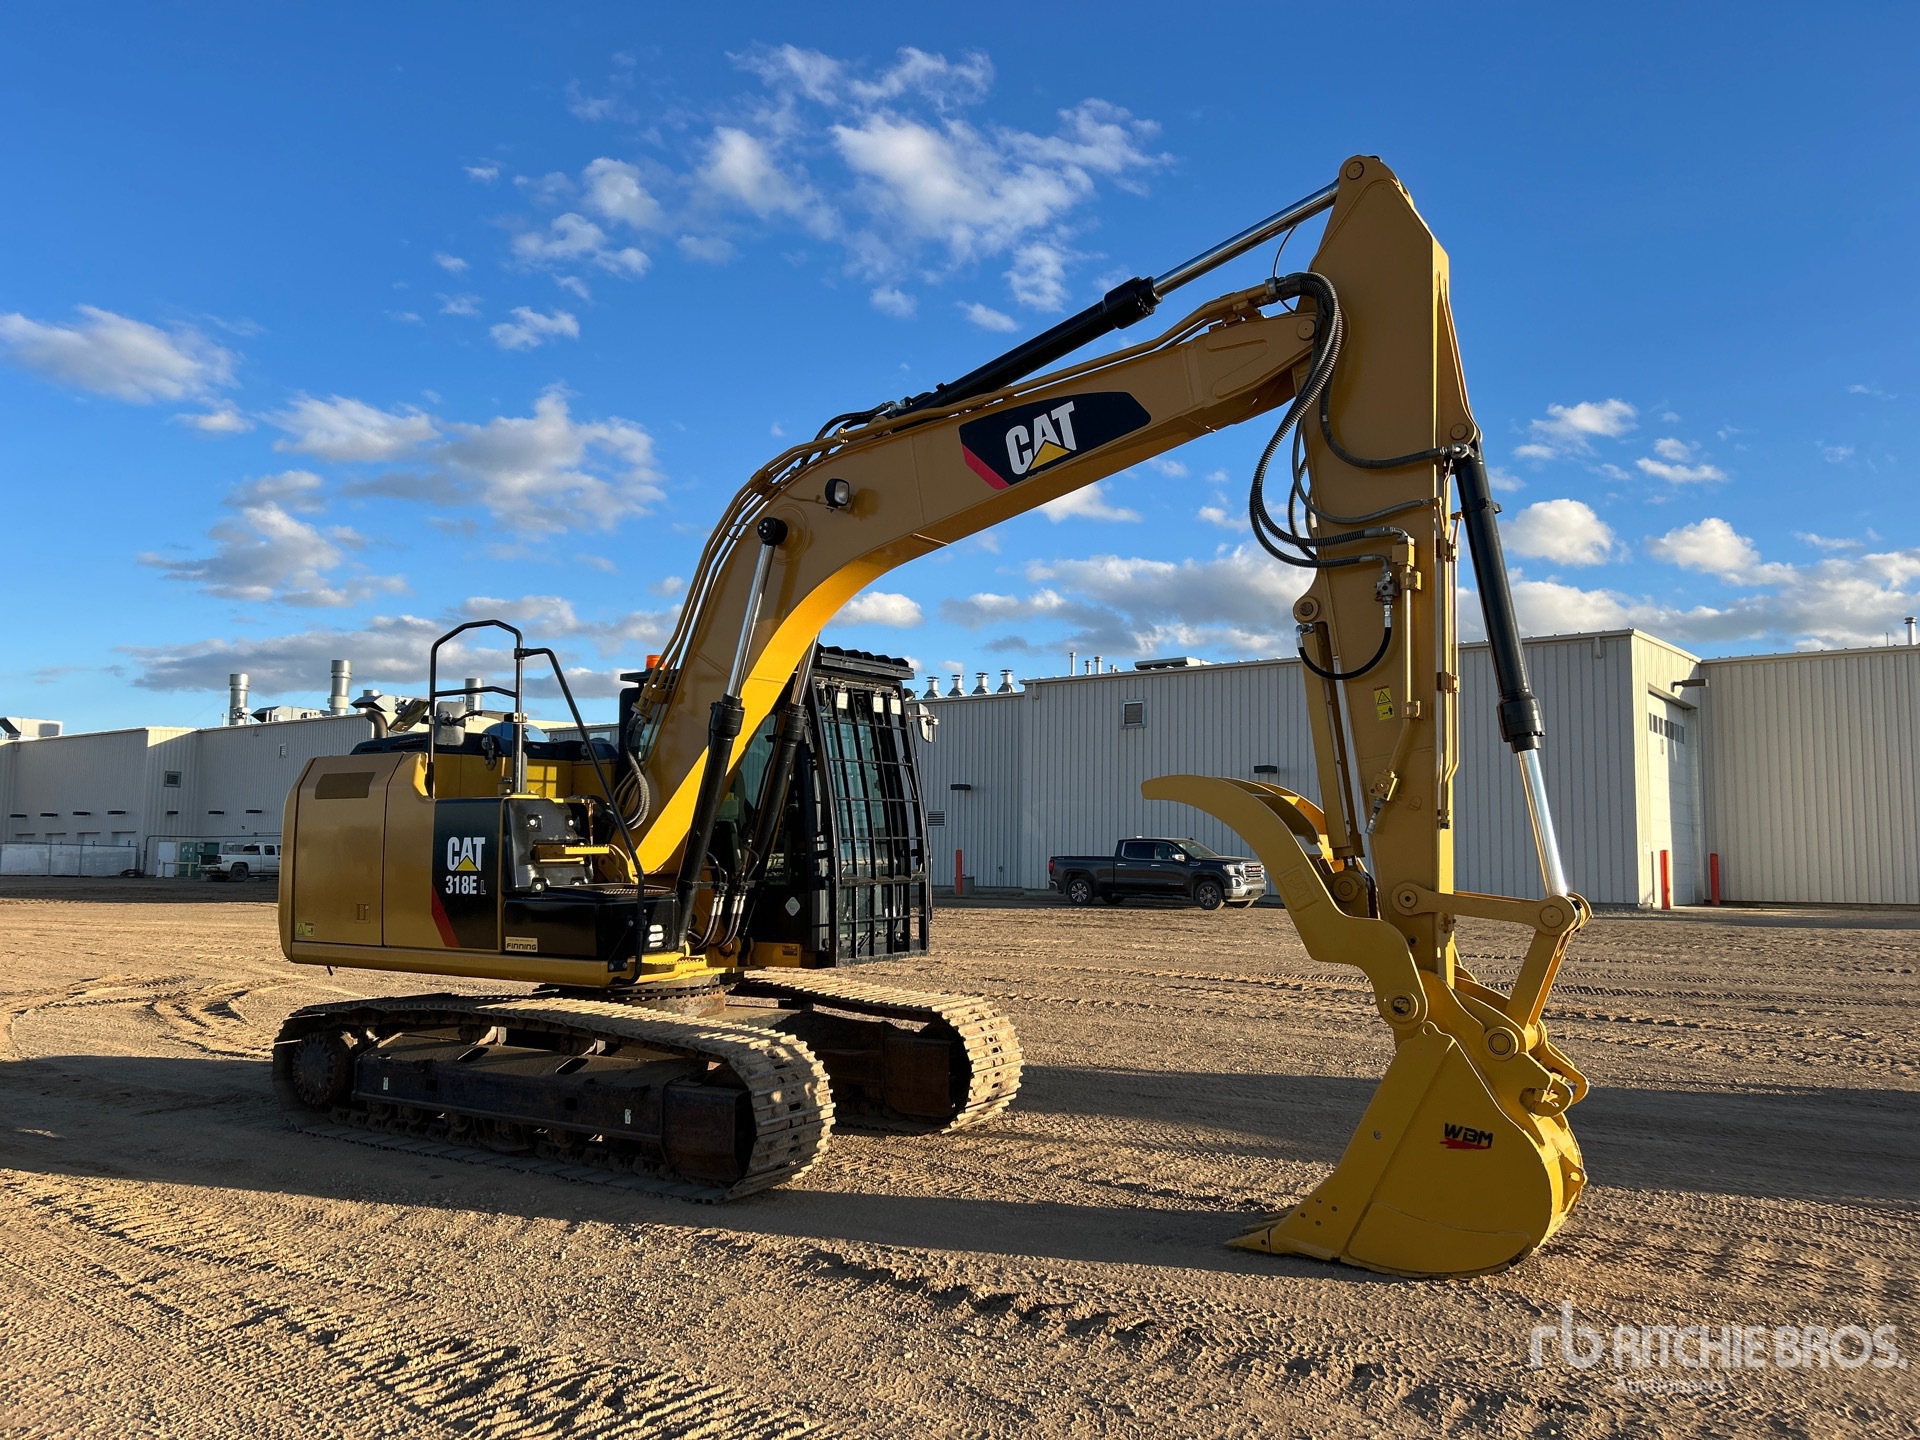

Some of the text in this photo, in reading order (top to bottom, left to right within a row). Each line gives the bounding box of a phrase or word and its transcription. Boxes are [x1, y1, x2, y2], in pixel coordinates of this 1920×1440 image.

[1005, 400, 1077, 475] CAT
[446, 836, 486, 871] CAT
[445, 875, 477, 894] 318E
[506, 942, 537, 950] FINNING
[1444, 1122, 1494, 1148] WBM
